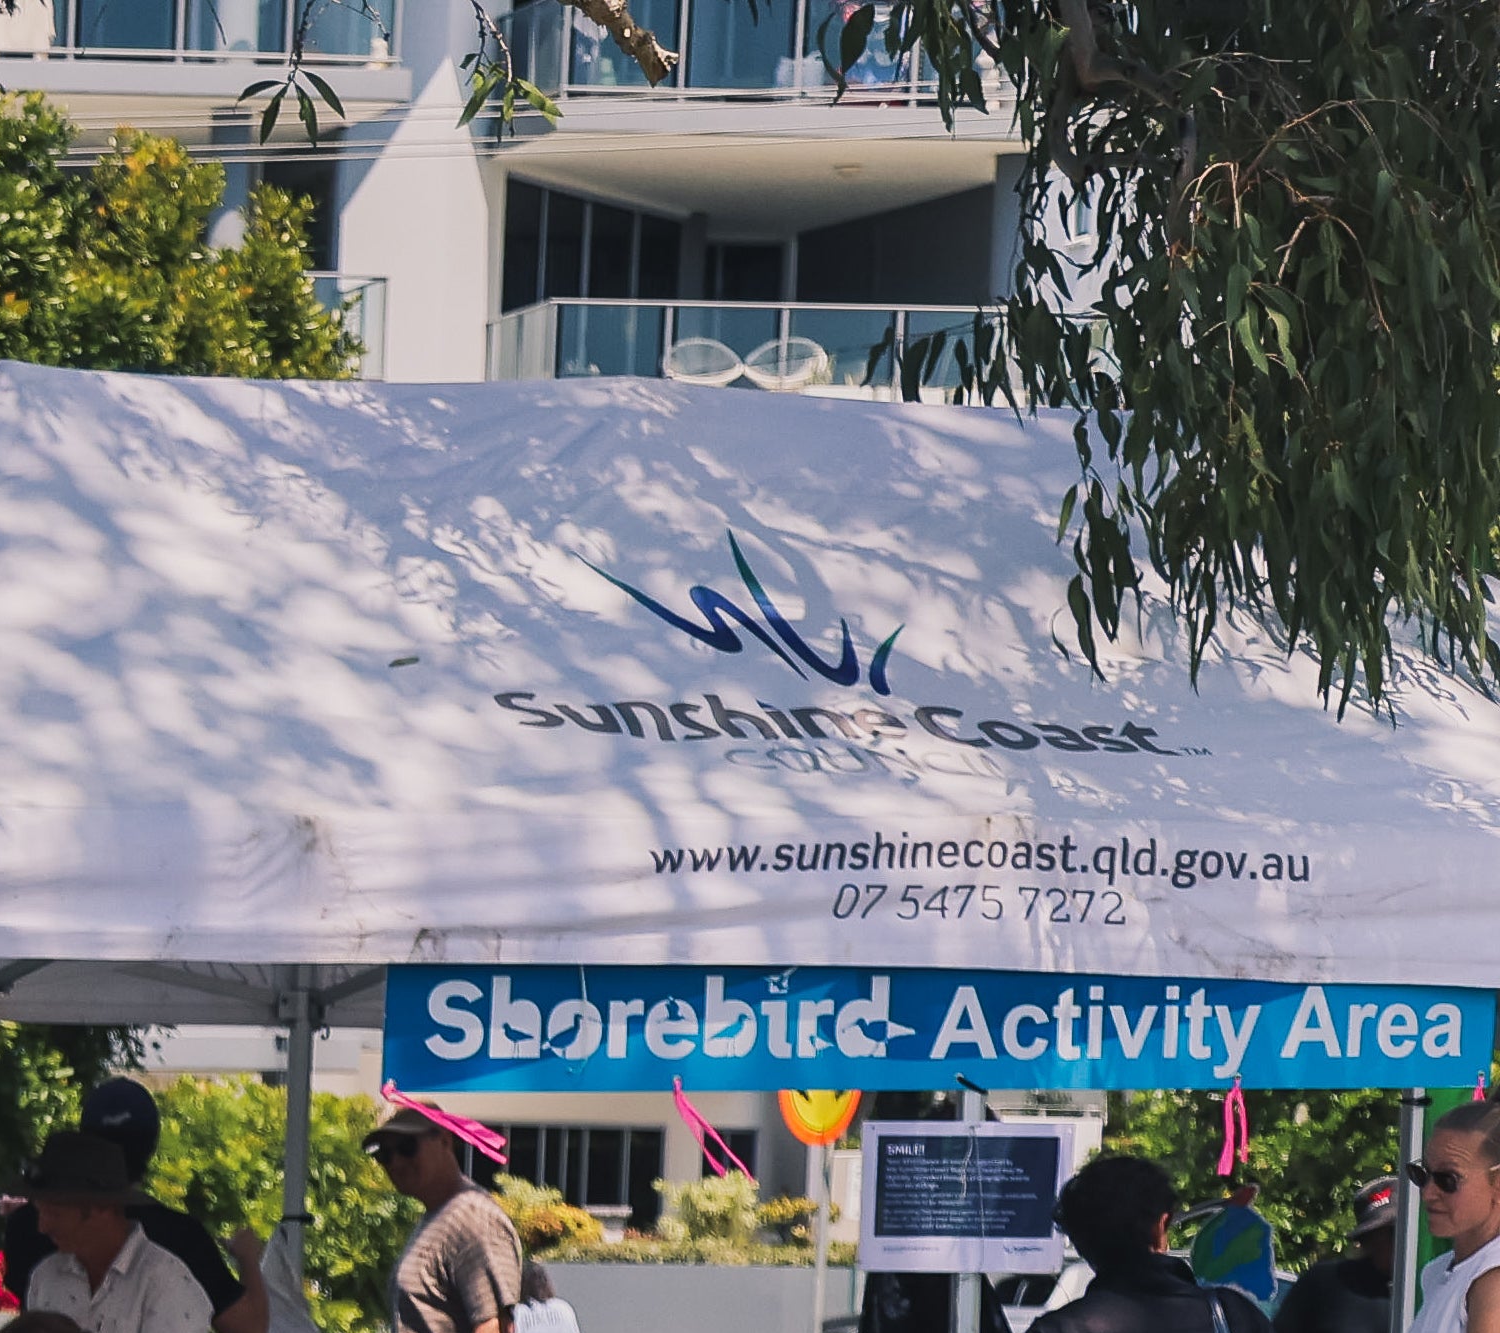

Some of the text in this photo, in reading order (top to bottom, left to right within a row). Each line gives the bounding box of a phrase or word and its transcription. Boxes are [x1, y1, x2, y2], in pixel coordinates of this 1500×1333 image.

[493, 691, 908, 742] Sunshine
[914, 706, 1181, 757] Coast
[648, 831, 1312, 889] www.sunshinecoast.qld.gov.au
[831, 883, 1128, 926] 07 5475 7272
[424, 974, 1464, 1078] Shorebird Activity Area
